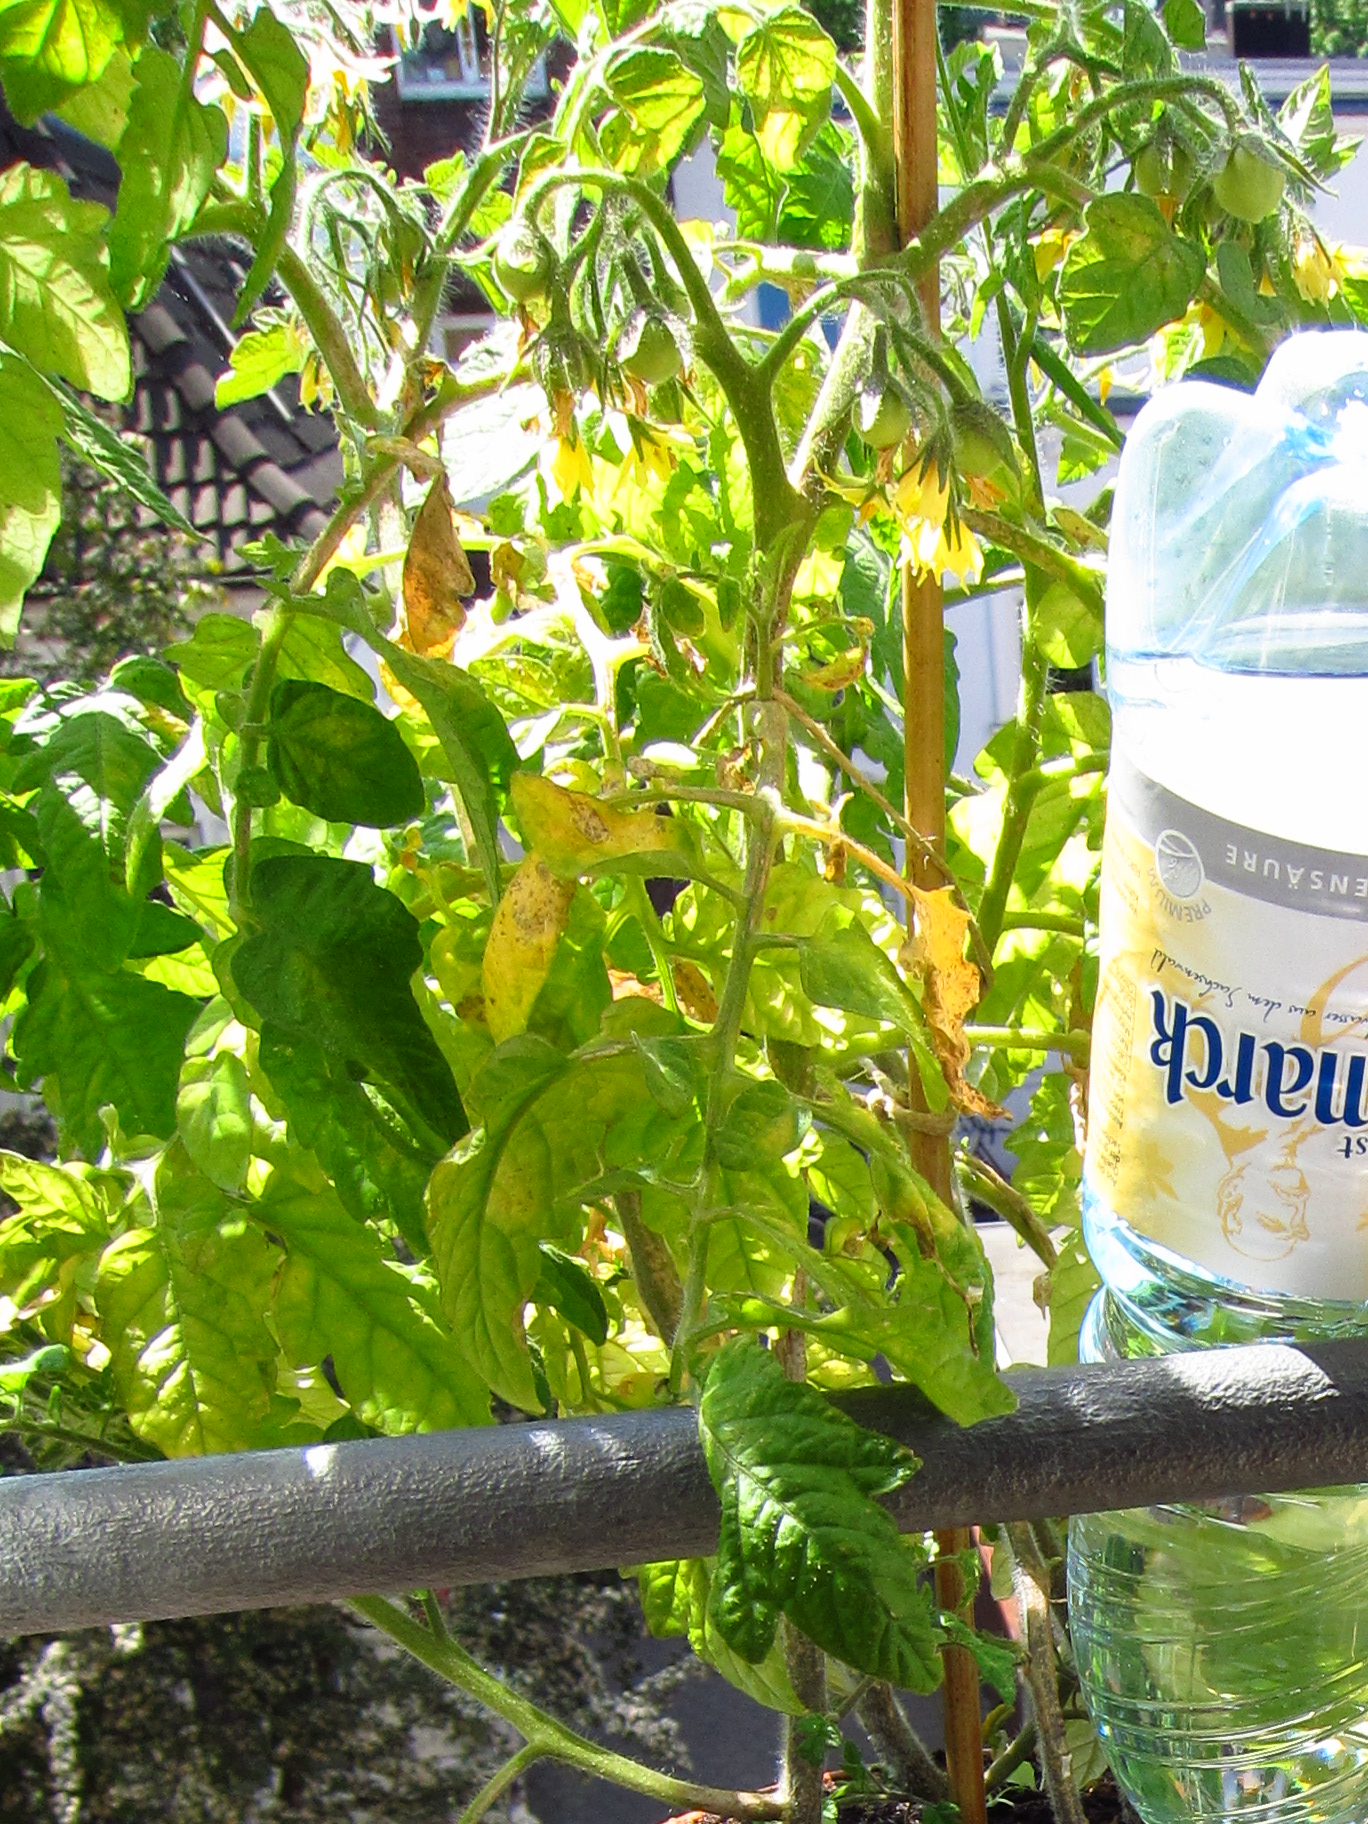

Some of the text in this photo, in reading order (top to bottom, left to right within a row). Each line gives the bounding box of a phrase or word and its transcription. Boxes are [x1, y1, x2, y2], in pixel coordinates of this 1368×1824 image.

[1147, 867, 1213, 925] PREMIUM
[1150, 947, 1241, 1008] Sachsenwald
[1247, 993, 1282, 1024] dem
[1287, 1005, 1318, 1021] aus
